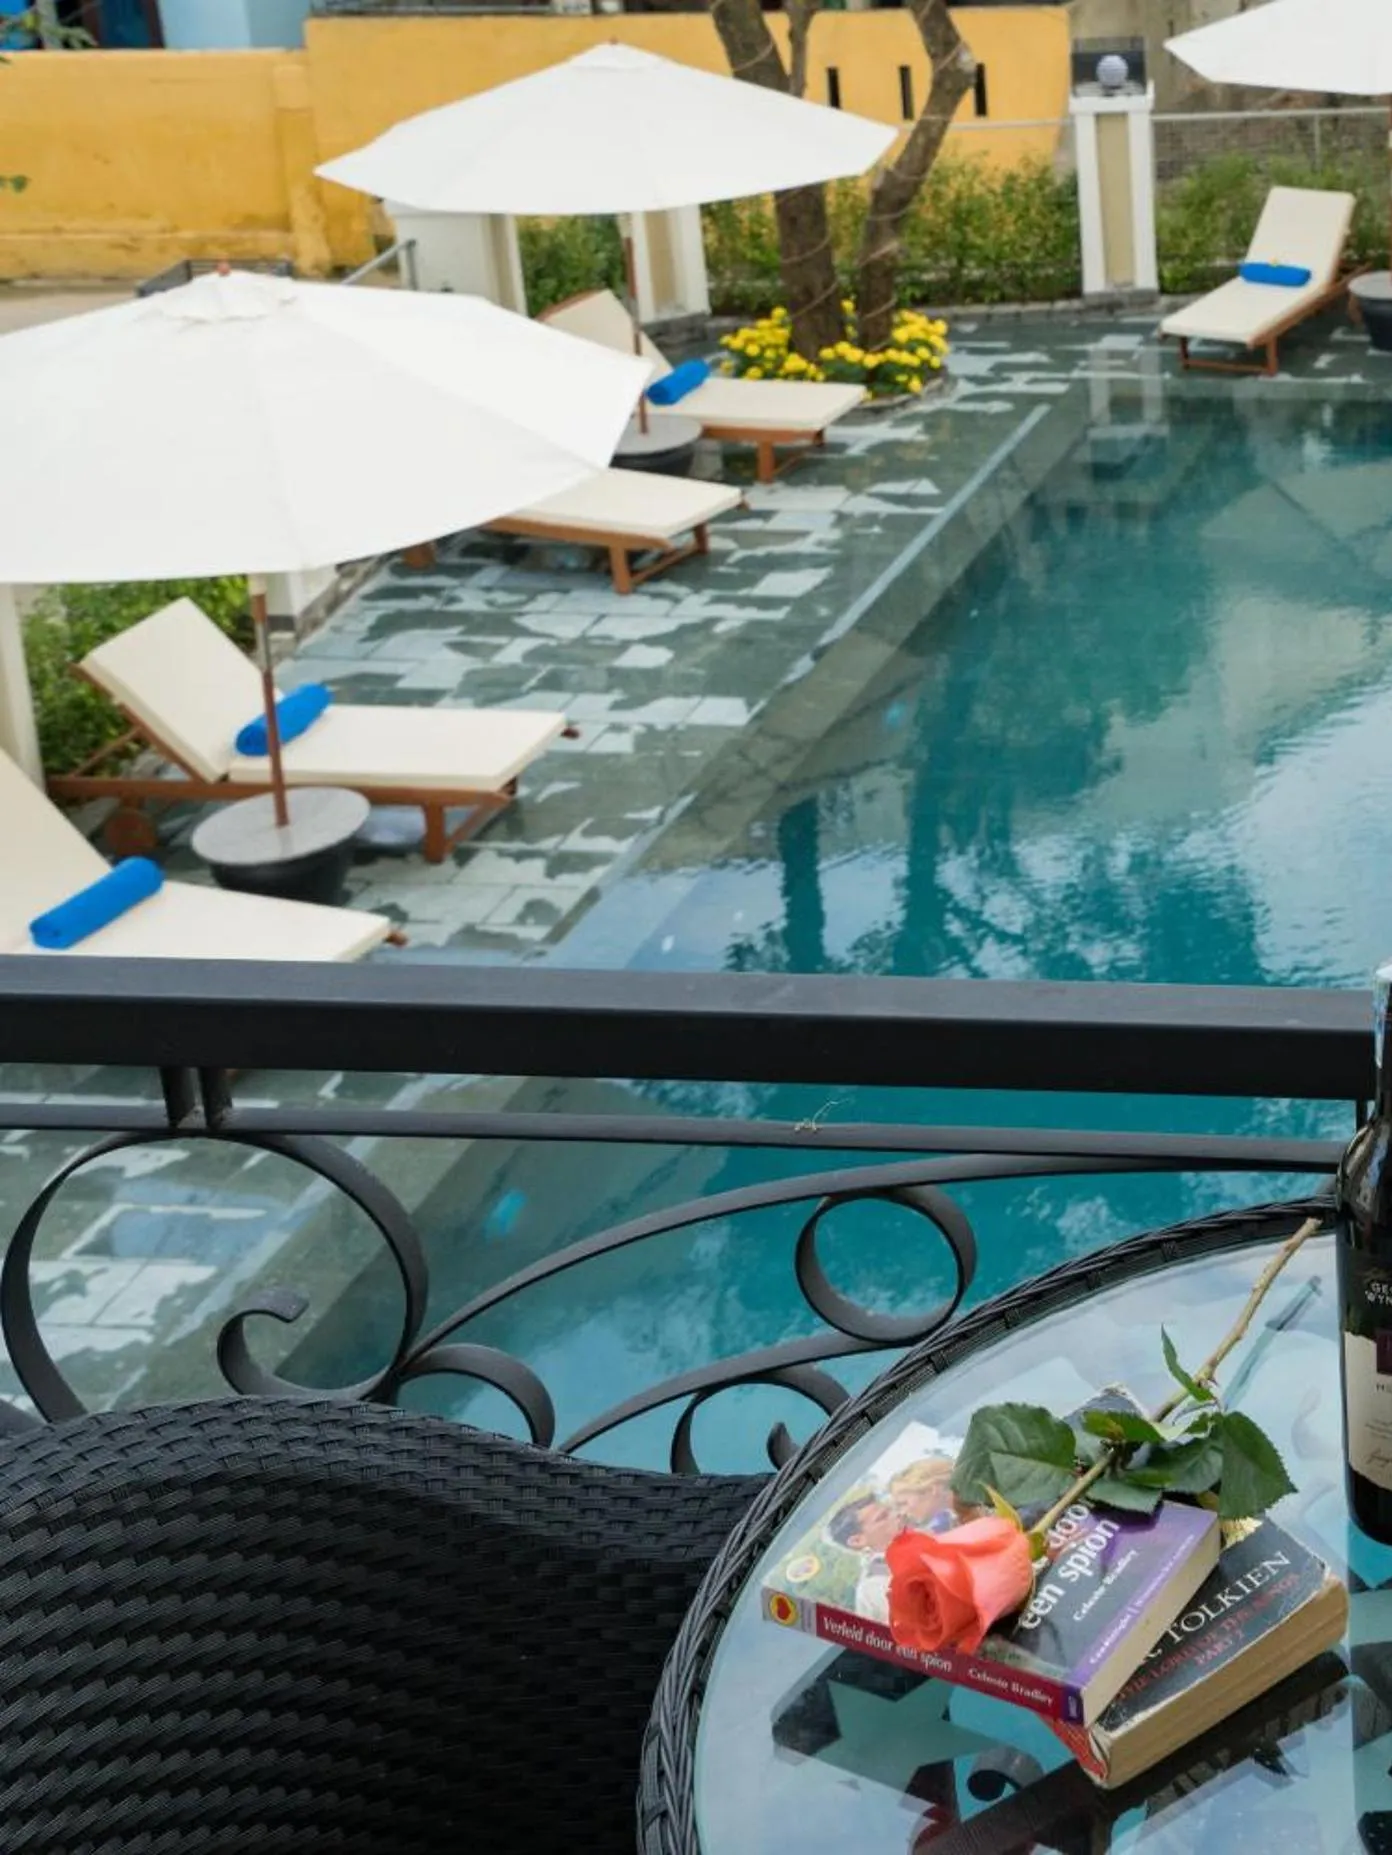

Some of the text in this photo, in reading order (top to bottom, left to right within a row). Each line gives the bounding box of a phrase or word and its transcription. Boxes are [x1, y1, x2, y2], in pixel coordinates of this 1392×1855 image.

[1020, 1583, 1066, 1629] een
[1058, 1519, 1120, 1582] spion
[1166, 1551, 1291, 1644] TOLKIEN
[865, 1630, 893, 1651] door
[920, 1652, 953, 1673] spion
